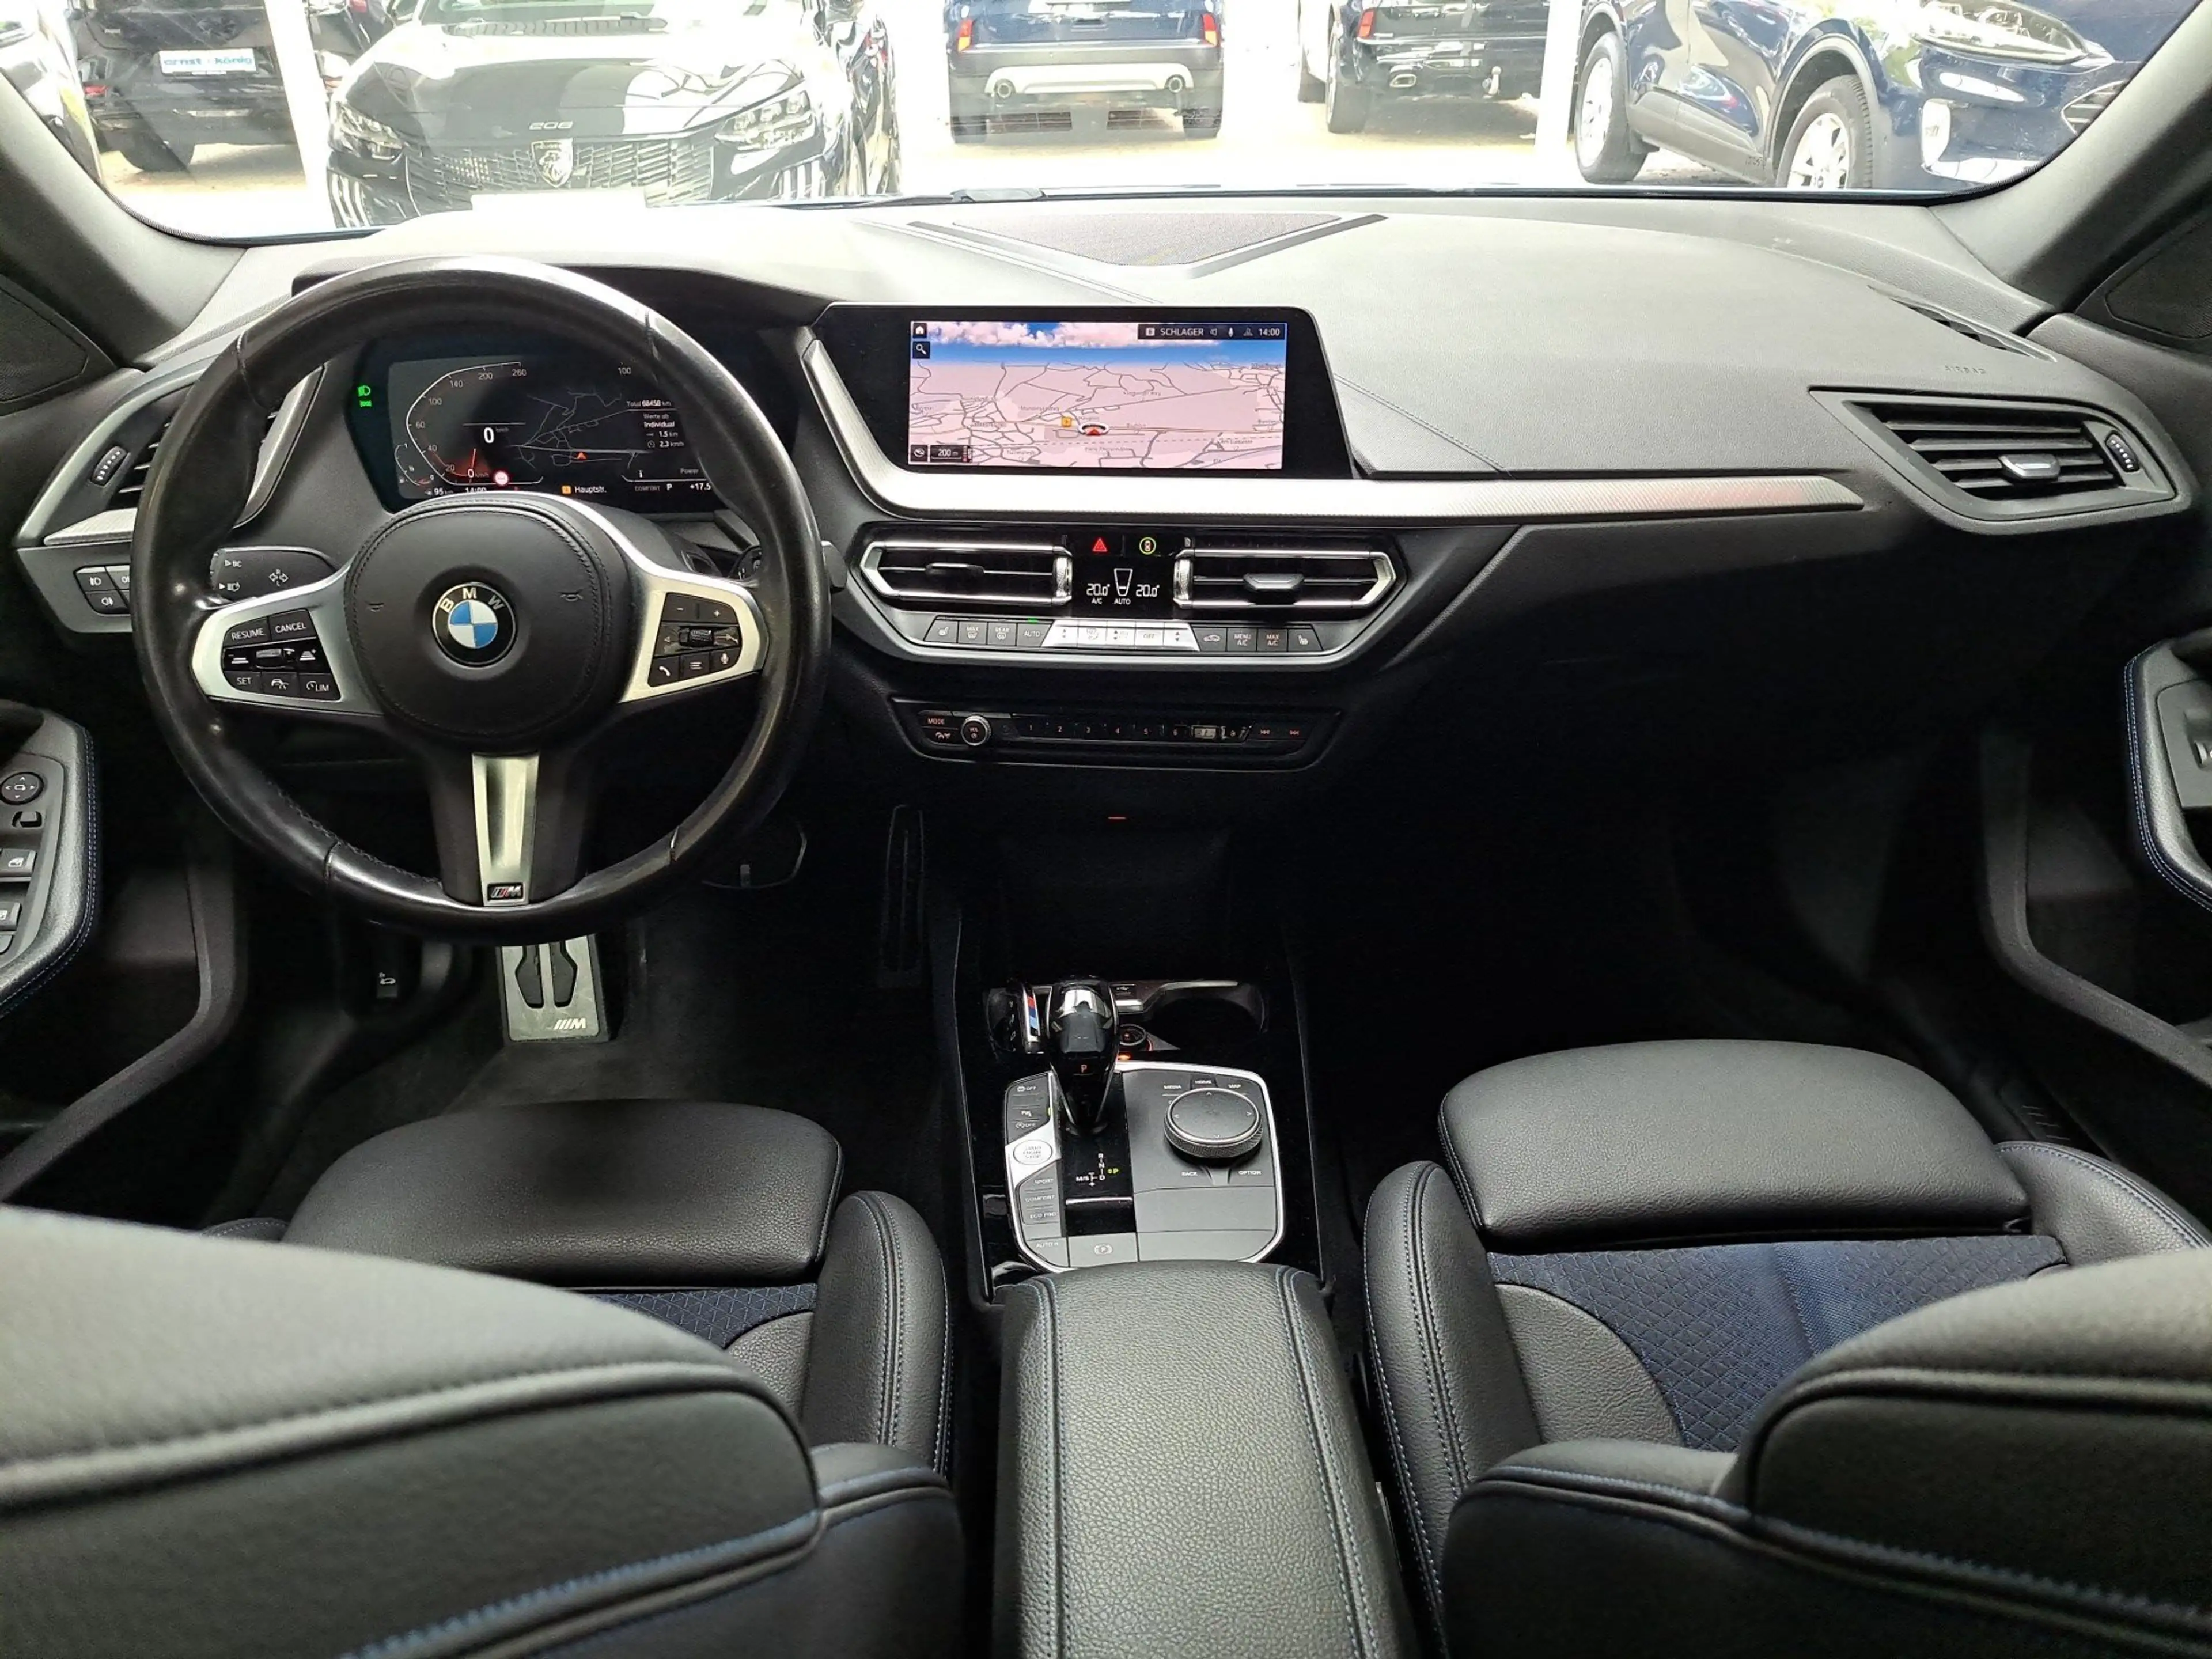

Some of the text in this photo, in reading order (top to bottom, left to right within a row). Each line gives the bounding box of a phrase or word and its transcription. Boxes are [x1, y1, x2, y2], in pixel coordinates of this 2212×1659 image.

[1160, 328, 1204, 336] SCHLAGER
[1258, 328, 1280, 336] 14:00
[483, 427, 494, 444] 0
[434, 488, 444, 496] 95
[440, 586, 505, 613] BMW
[275, 622, 307, 634] CANCEL
[231, 627, 264, 641] RESUME
[237, 677, 252, 685] SET
[315, 683, 329, 692] LIM
[1081, 1065, 1087, 1073] P
